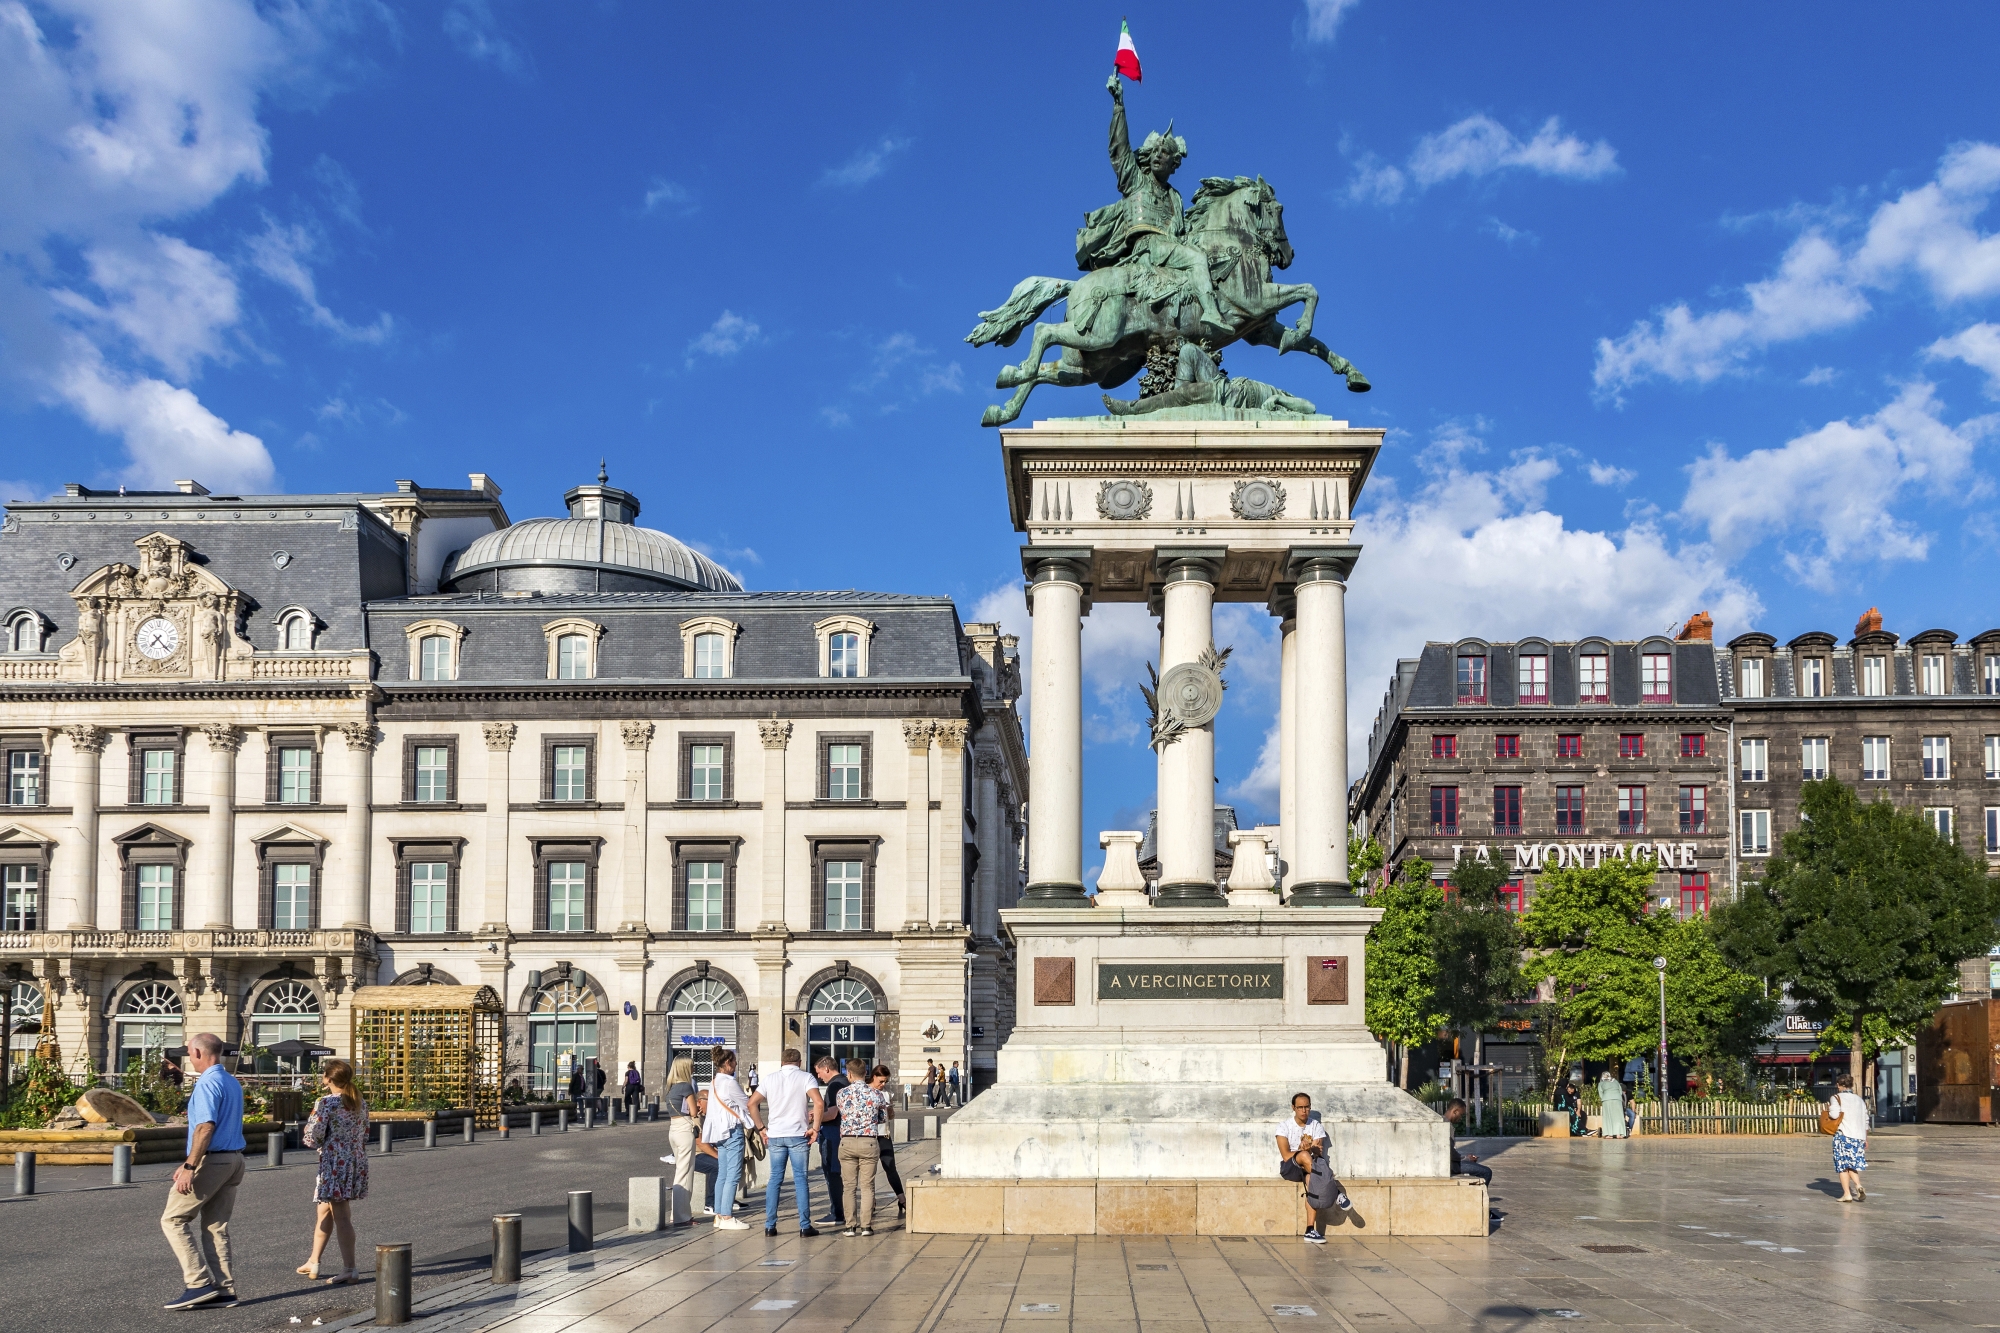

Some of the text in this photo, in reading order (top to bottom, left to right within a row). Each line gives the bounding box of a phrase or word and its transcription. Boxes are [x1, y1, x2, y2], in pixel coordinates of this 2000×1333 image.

[1452, 842, 1698, 870] LA MONTAGNE
[1110, 974, 1272, 988] A VERCINGETORIX
[1909, 1053, 1916, 1063] 9
